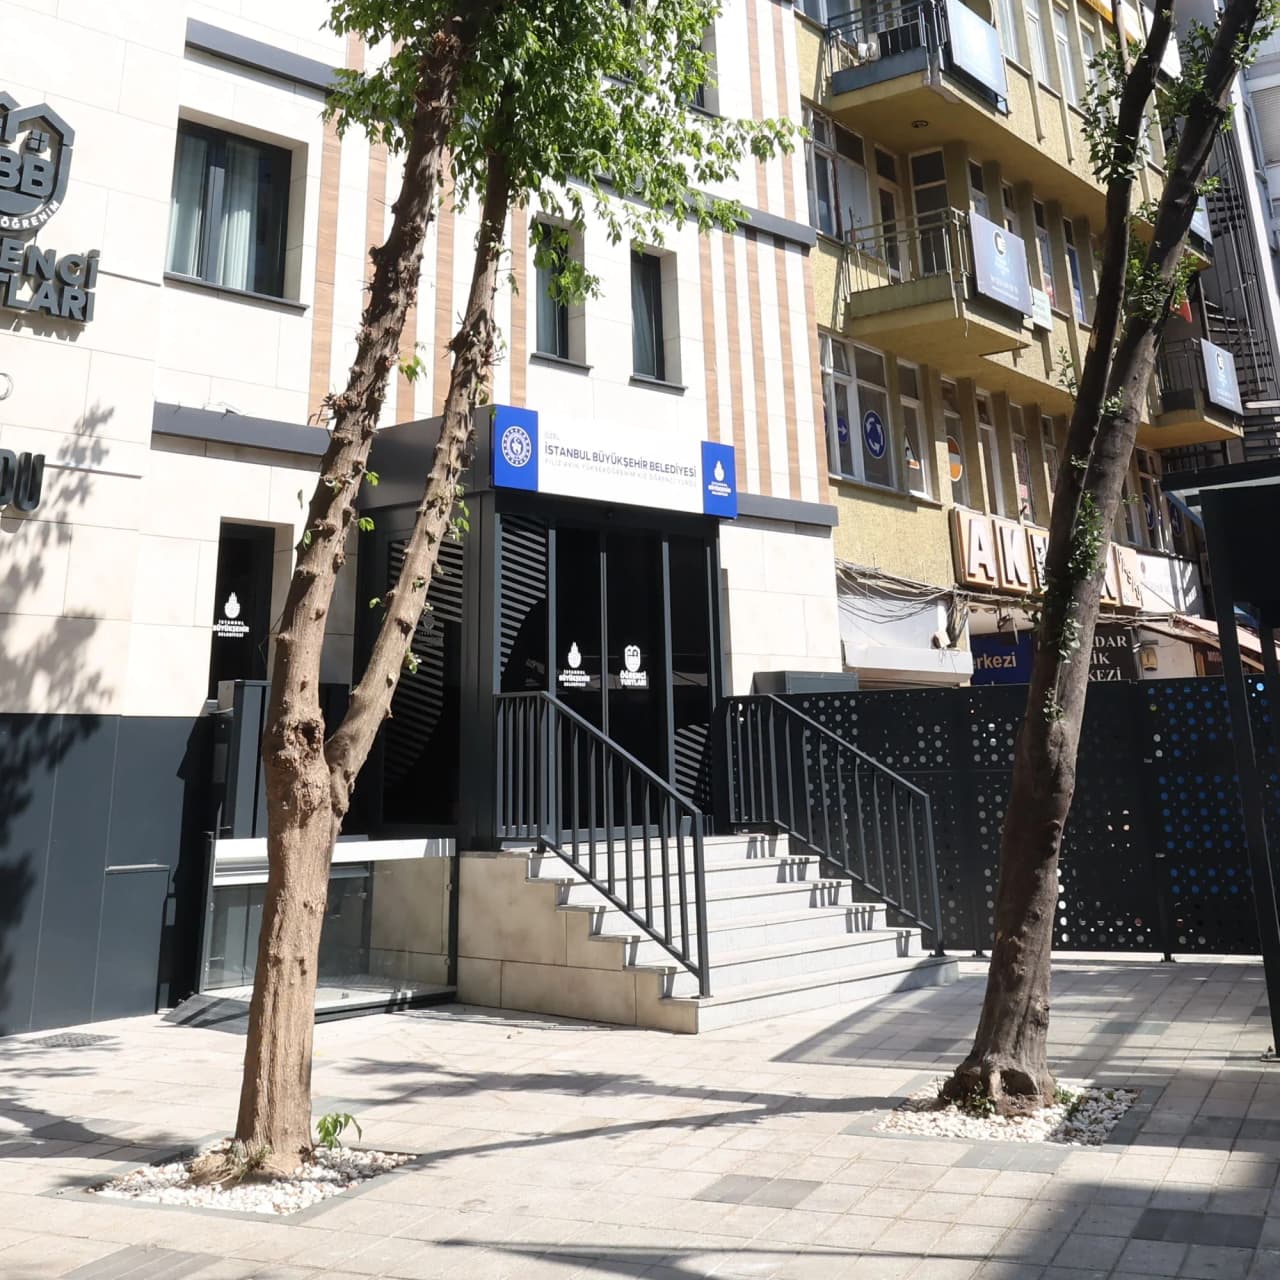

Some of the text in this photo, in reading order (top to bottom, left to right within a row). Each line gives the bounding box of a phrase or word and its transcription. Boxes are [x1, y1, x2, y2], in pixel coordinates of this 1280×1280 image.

[544, 440, 592, 461] İSTANBUL
[592, 449, 648, 472] BÜYÜKŞEHİR
[649, 460, 697, 479] BELEDİYESİ
[973, 650, 1017, 670] rkezi
[1090, 650, 1111, 665] İK
